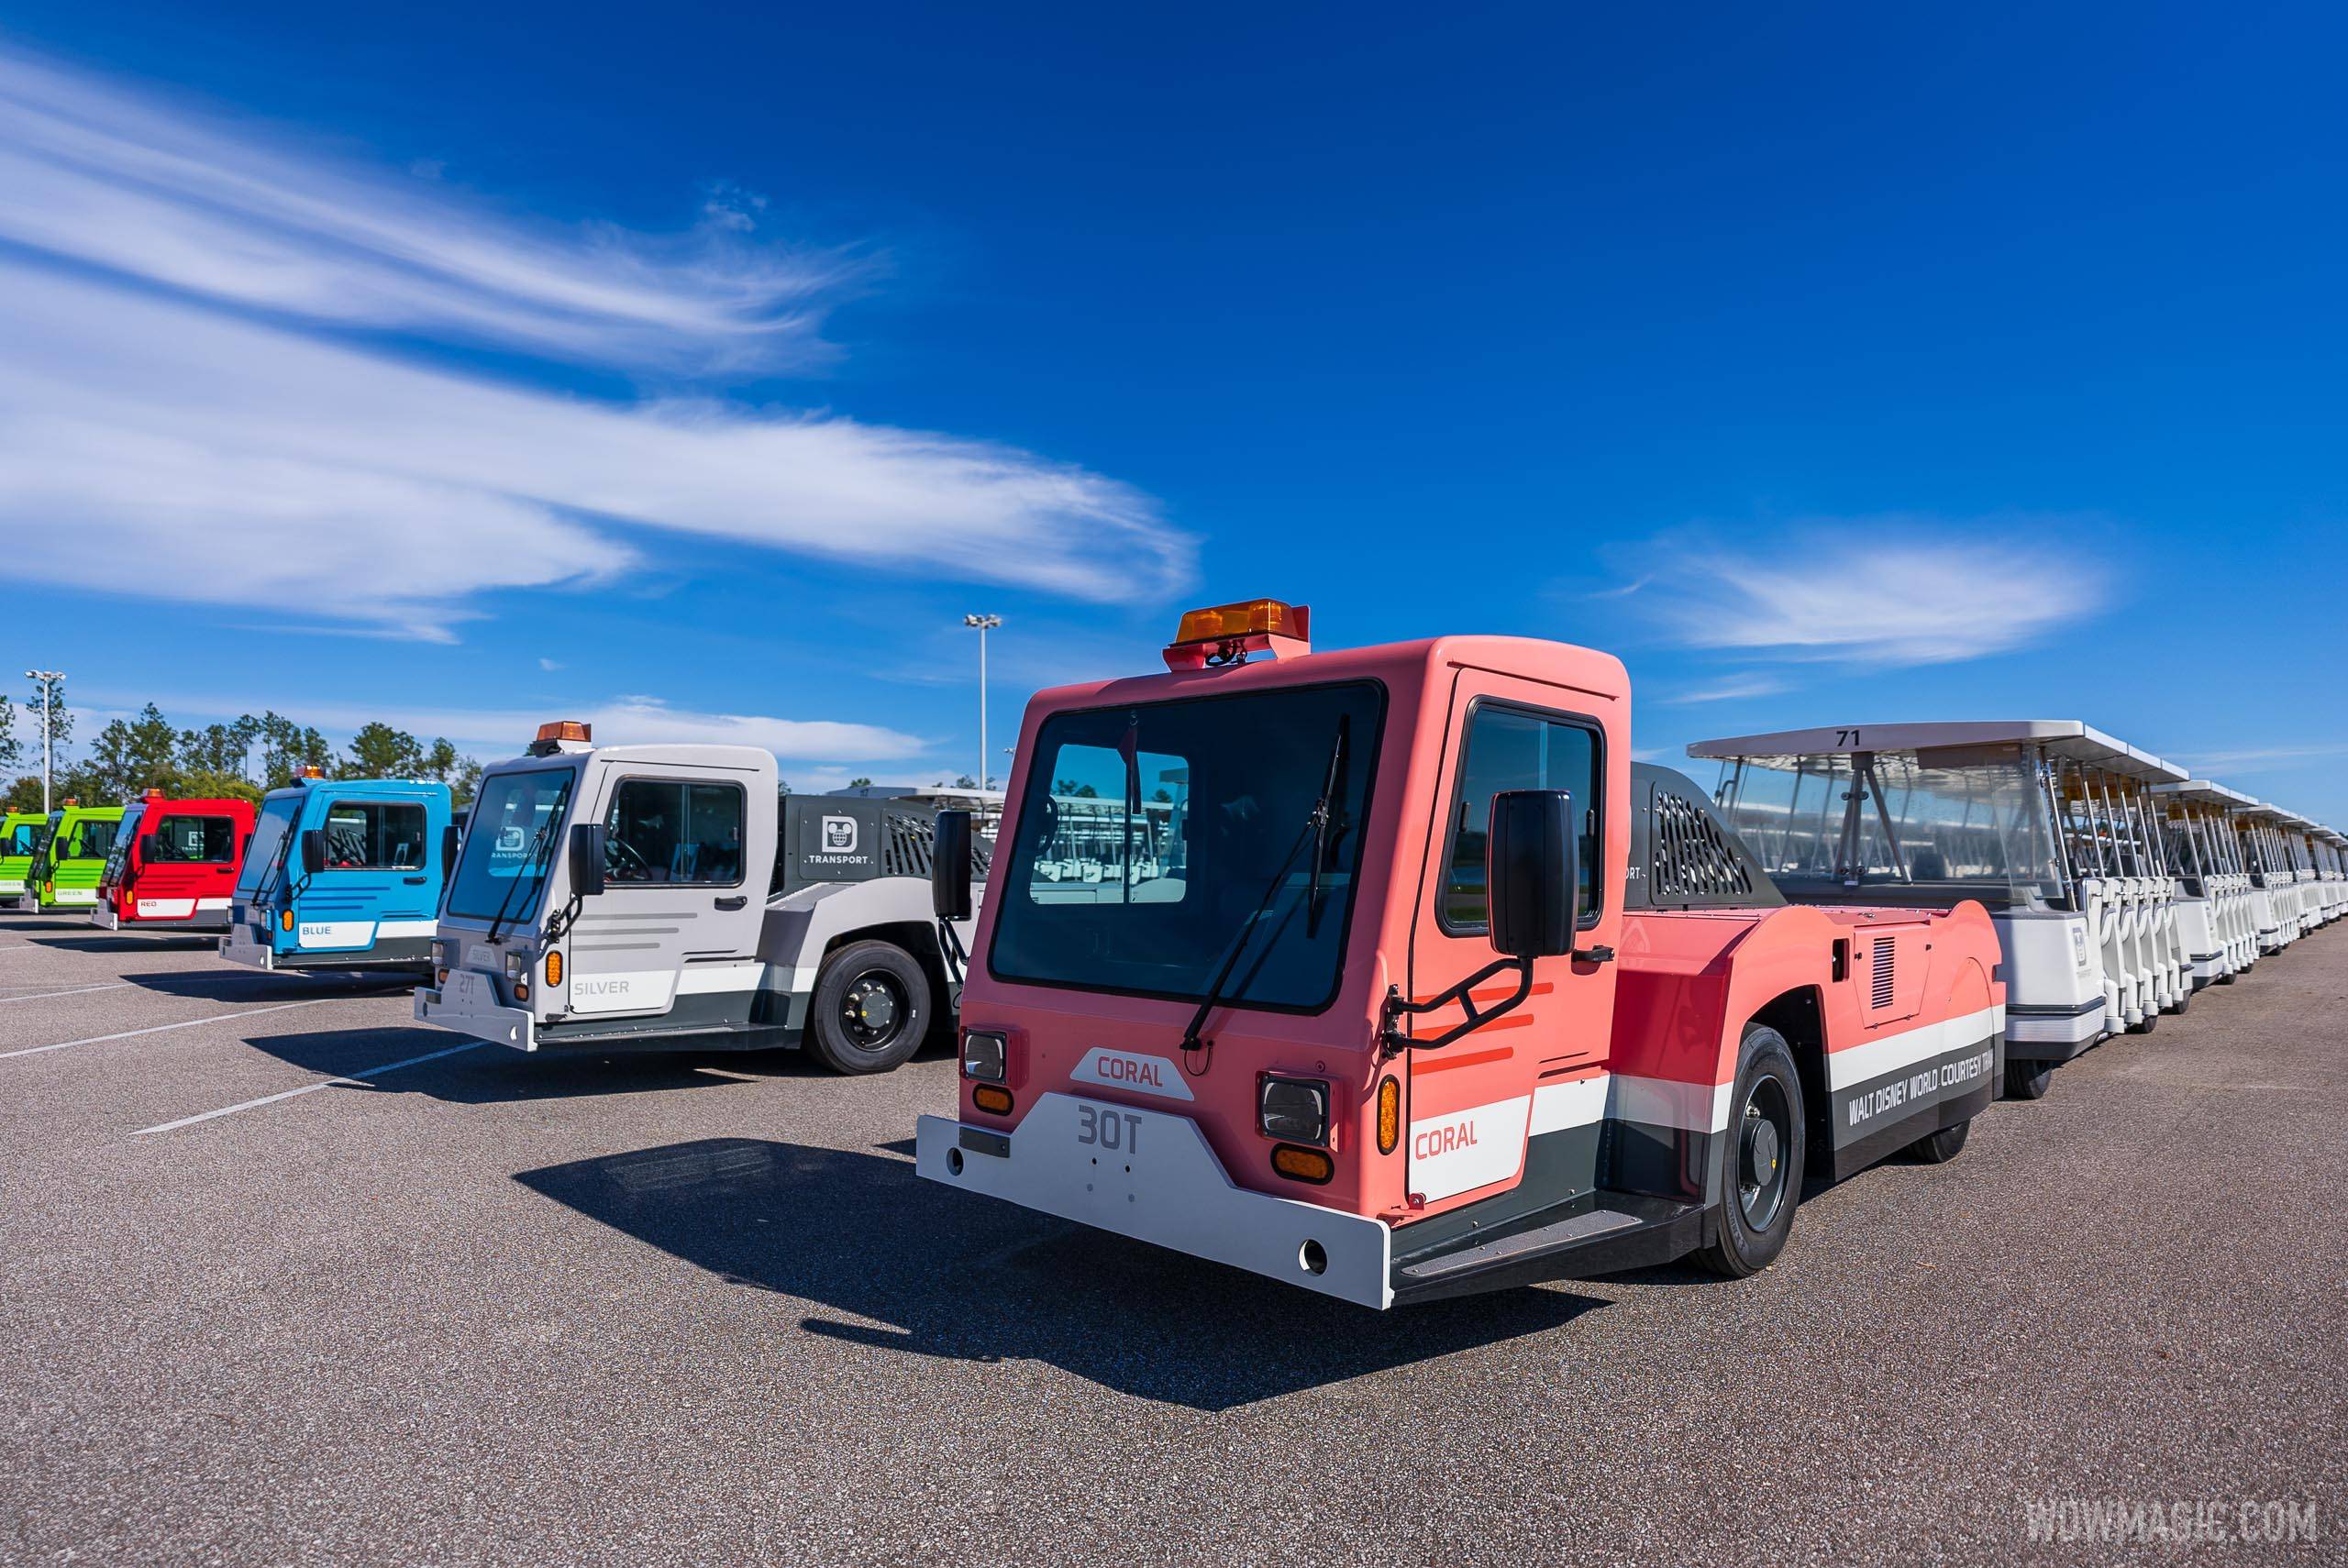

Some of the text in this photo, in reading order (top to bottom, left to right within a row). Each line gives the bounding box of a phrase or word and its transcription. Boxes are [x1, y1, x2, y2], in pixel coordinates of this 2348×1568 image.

[1836, 729, 1860, 747] 71
[808, 855, 869, 865] TRANSPORT
[302, 926, 331, 935] BLUE
[574, 981, 629, 996] SILVER
[1098, 1056, 1163, 1087] CORAL
[1849, 1091, 1874, 1126] WALT
[1876, 1079, 1908, 1114] DISNEY
[1910, 1069, 1937, 1099] WORLD
[1941, 1055, 1982, 1087] COURTESY
[1079, 1104, 1142, 1154] 30T
[1415, 1121, 1478, 1160] CORAL
